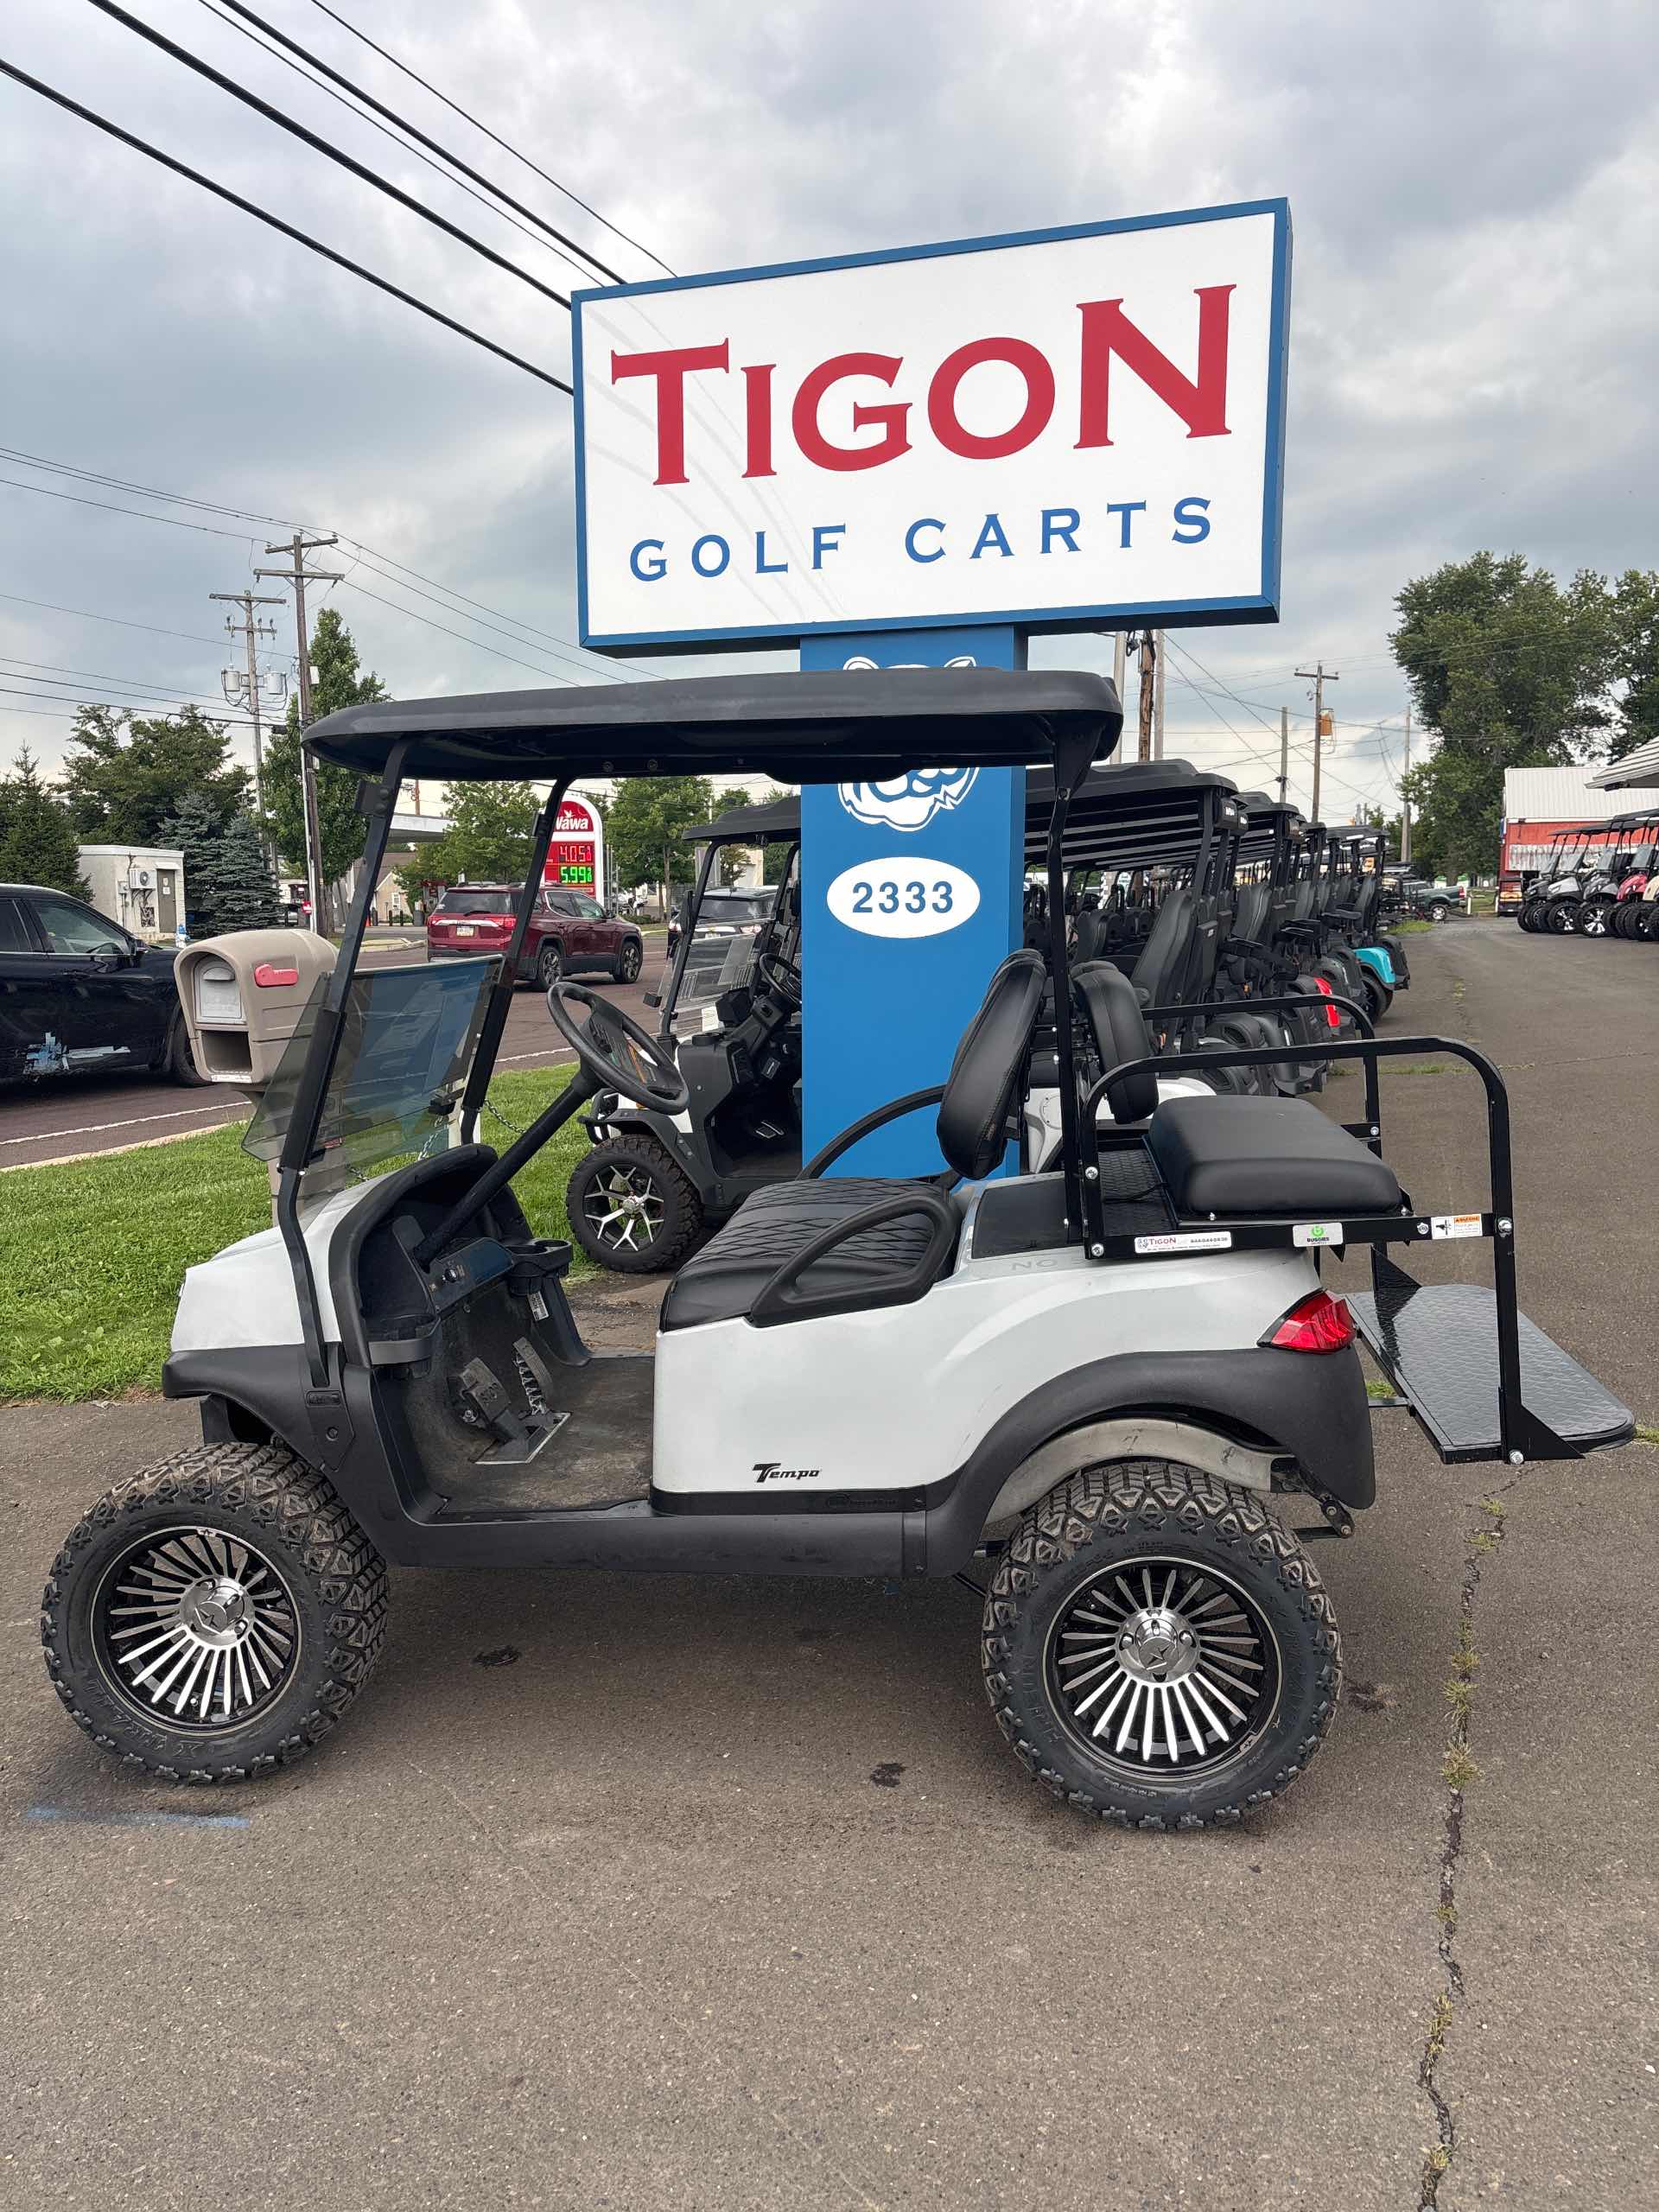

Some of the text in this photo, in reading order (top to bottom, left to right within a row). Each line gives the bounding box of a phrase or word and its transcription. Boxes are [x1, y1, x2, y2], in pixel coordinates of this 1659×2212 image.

[611, 283, 1237, 486] TIGON
[630, 497, 1211, 582] GOLF CARTS
[852, 880, 953, 913] 2333
[753, 1463, 820, 1483] Tempo
